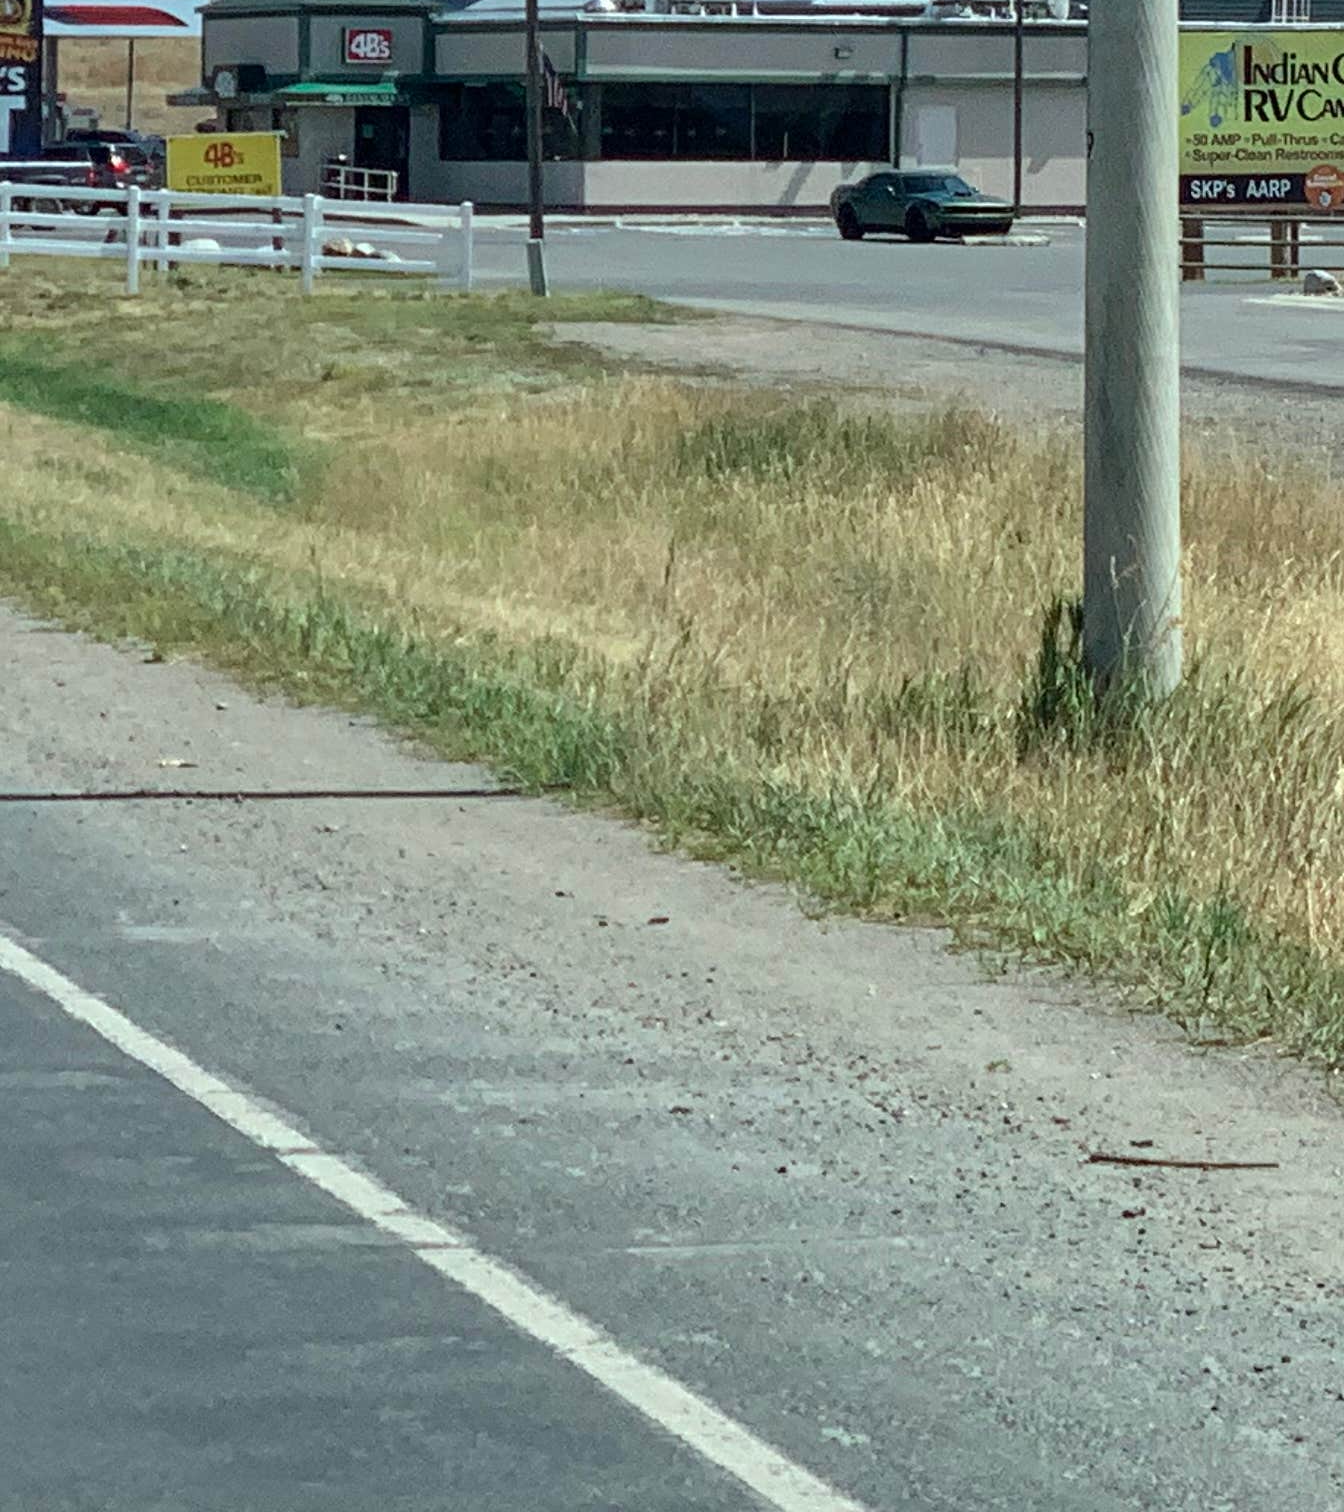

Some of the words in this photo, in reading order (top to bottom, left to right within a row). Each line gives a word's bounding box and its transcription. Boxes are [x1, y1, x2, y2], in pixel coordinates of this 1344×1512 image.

[1244, 88, 1295, 122] RV
[1211, 133, 1242, 146] AMP
[1275, 148, 1344, 161] Restrooms
[1190, 179, 1236, 198] SKP's
[1246, 179, 1292, 198] AARP
